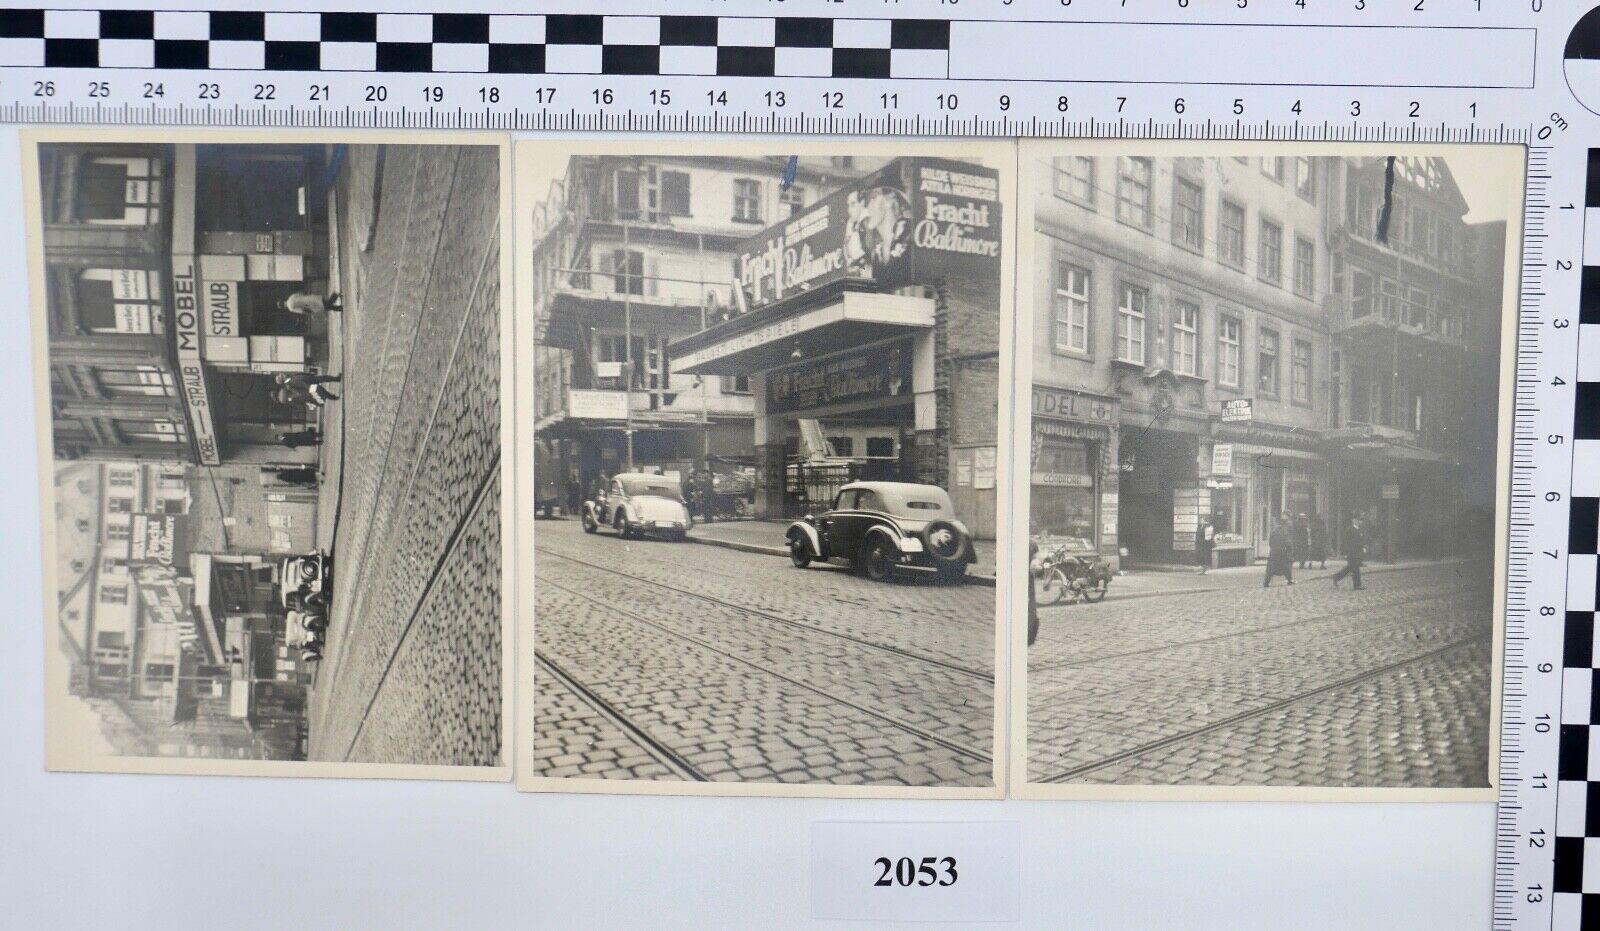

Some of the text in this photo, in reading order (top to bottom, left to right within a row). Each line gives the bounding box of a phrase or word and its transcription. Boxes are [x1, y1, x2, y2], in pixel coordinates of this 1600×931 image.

[34, 81, 1477, 119] 26 25 24 23 22 21 20 19 18 17 16 15 14 13 12 11 10 9 8 7 6 5 4 3 2 1
[1537, 112, 1569, 140] 0 cm
[924, 195, 990, 228] Fracht
[914, 219, 999, 257] Baltimore
[174, 264, 198, 351] MÖBEL
[210, 282, 232, 336] STRAUB
[182, 366, 208, 407] STRAUB
[1526, 203, 1575, 904] 1 2 3 4 5 6 7 8 9 10 11 12 13
[873, 856, 958, 887] 2053
